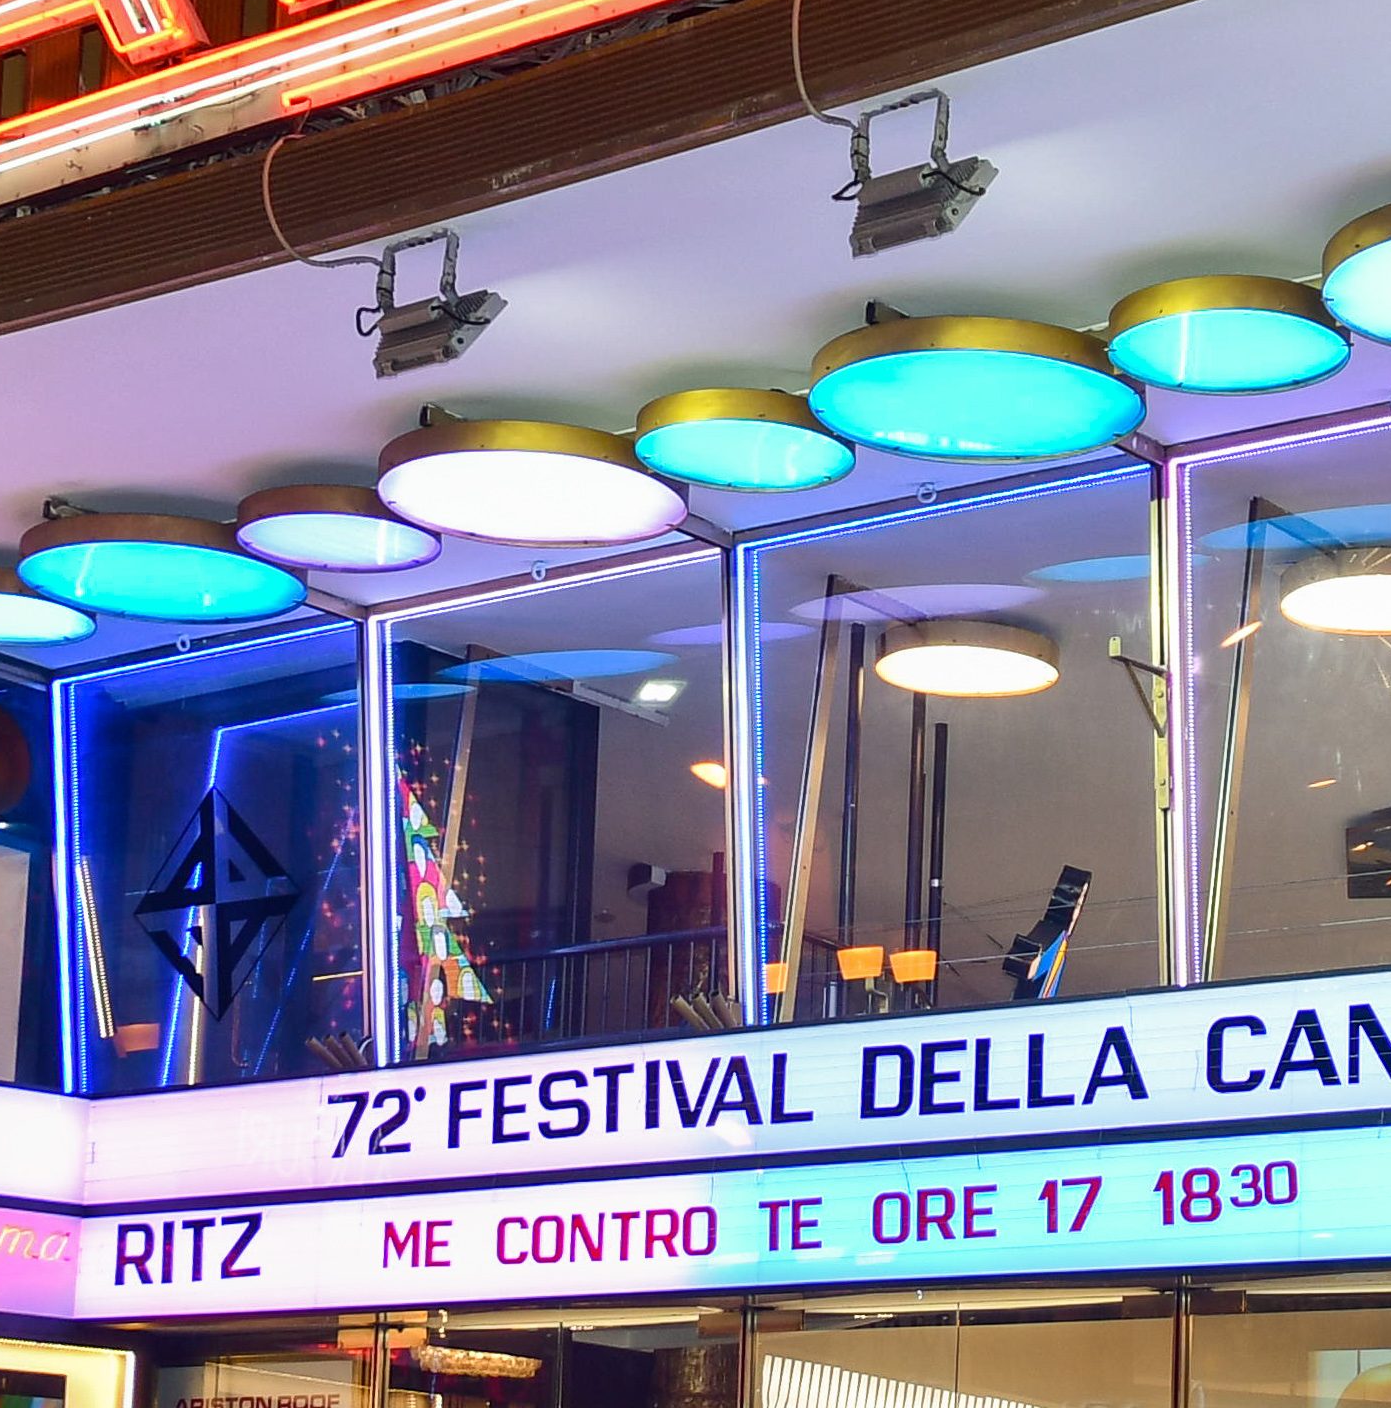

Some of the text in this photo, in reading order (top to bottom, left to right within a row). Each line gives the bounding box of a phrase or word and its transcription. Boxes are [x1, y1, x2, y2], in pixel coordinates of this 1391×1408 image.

[447, 1053, 814, 1149] FESTIVAL
[860, 1026, 1148, 1119] DELLA
[113, 1212, 263, 1286] RITZ
[382, 1219, 453, 1268] ME
[496, 1205, 718, 1266] CONTRO
[758, 1196, 824, 1252] TE
[872, 1183, 998, 1245] ORE
[1038, 1175, 1103, 1234] 17
